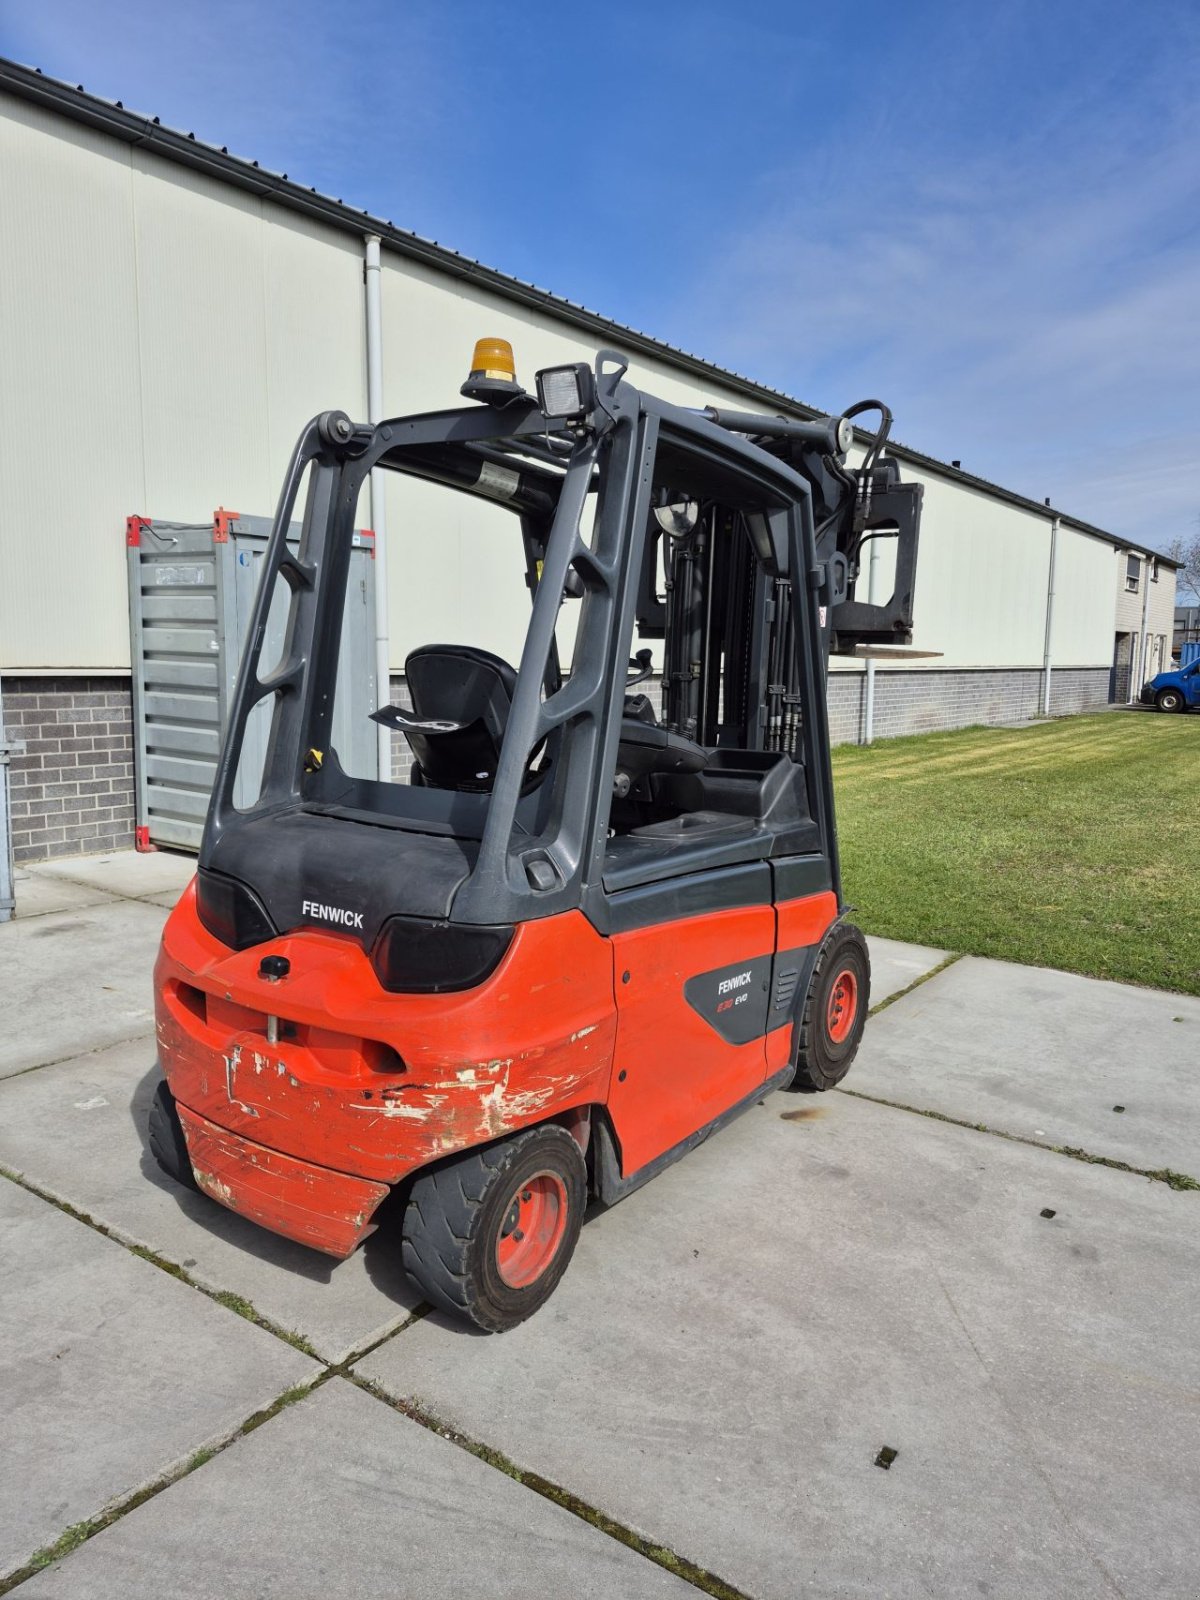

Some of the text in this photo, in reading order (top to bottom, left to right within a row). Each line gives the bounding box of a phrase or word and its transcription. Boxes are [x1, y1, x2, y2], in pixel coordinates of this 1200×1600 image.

[302, 900, 364, 929] FENWICK
[718, 970, 752, 995] FENWICK
[734, 993, 748, 1005] EVO
